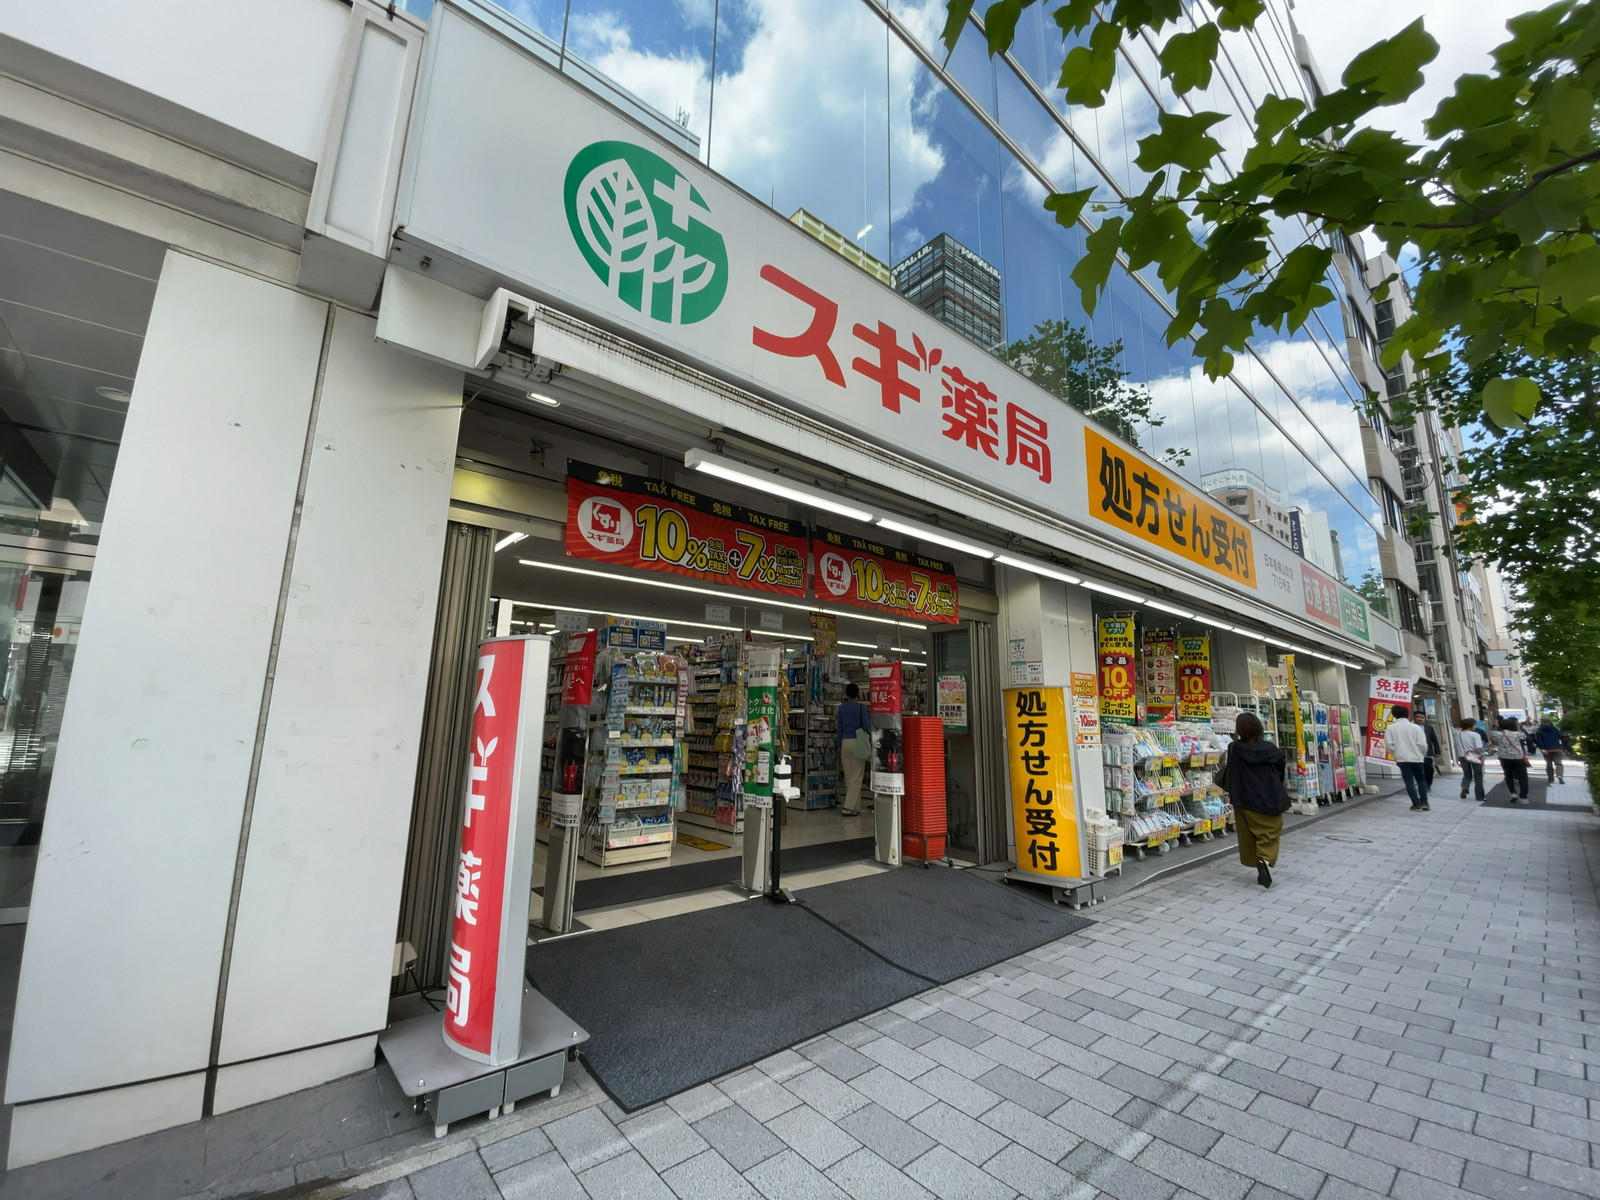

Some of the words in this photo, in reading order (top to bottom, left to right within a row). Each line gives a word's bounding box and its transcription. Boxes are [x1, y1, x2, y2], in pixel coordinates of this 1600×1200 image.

[752, 263, 1052, 484] スギ薬局
[644, 481, 668, 496] TAX
[671, 488, 696, 506] FREE
[712, 502, 732, 517] 免税
[1098, 446, 1252, 581] 処方せん受付
[747, 512, 767, 527] TAX
[768, 519, 789, 532] FREE
[587, 532, 625, 546] スギ薬局
[637, 506, 708, 569] 10%
[738, 530, 777, 582] 7%
[853, 540, 867, 549] TAX
[868, 544, 885, 556] FREE
[708, 560, 727, 572] FREE
[917, 557, 930, 568] TAX
[930, 561, 944, 571] FREE
[852, 558, 896, 606] 10%
[912, 572, 938, 614] 7%
[1343, 597, 1366, 633] 日用品
[1103, 688, 1130, 697] OFF
[1375, 678, 1410, 694] 免税
[1104, 701, 1131, 709] クーポン
[1183, 693, 1206, 701] OFF
[1101, 708, 1133, 716] プレゼント
[1015, 690, 1061, 871] 処方せん受付
